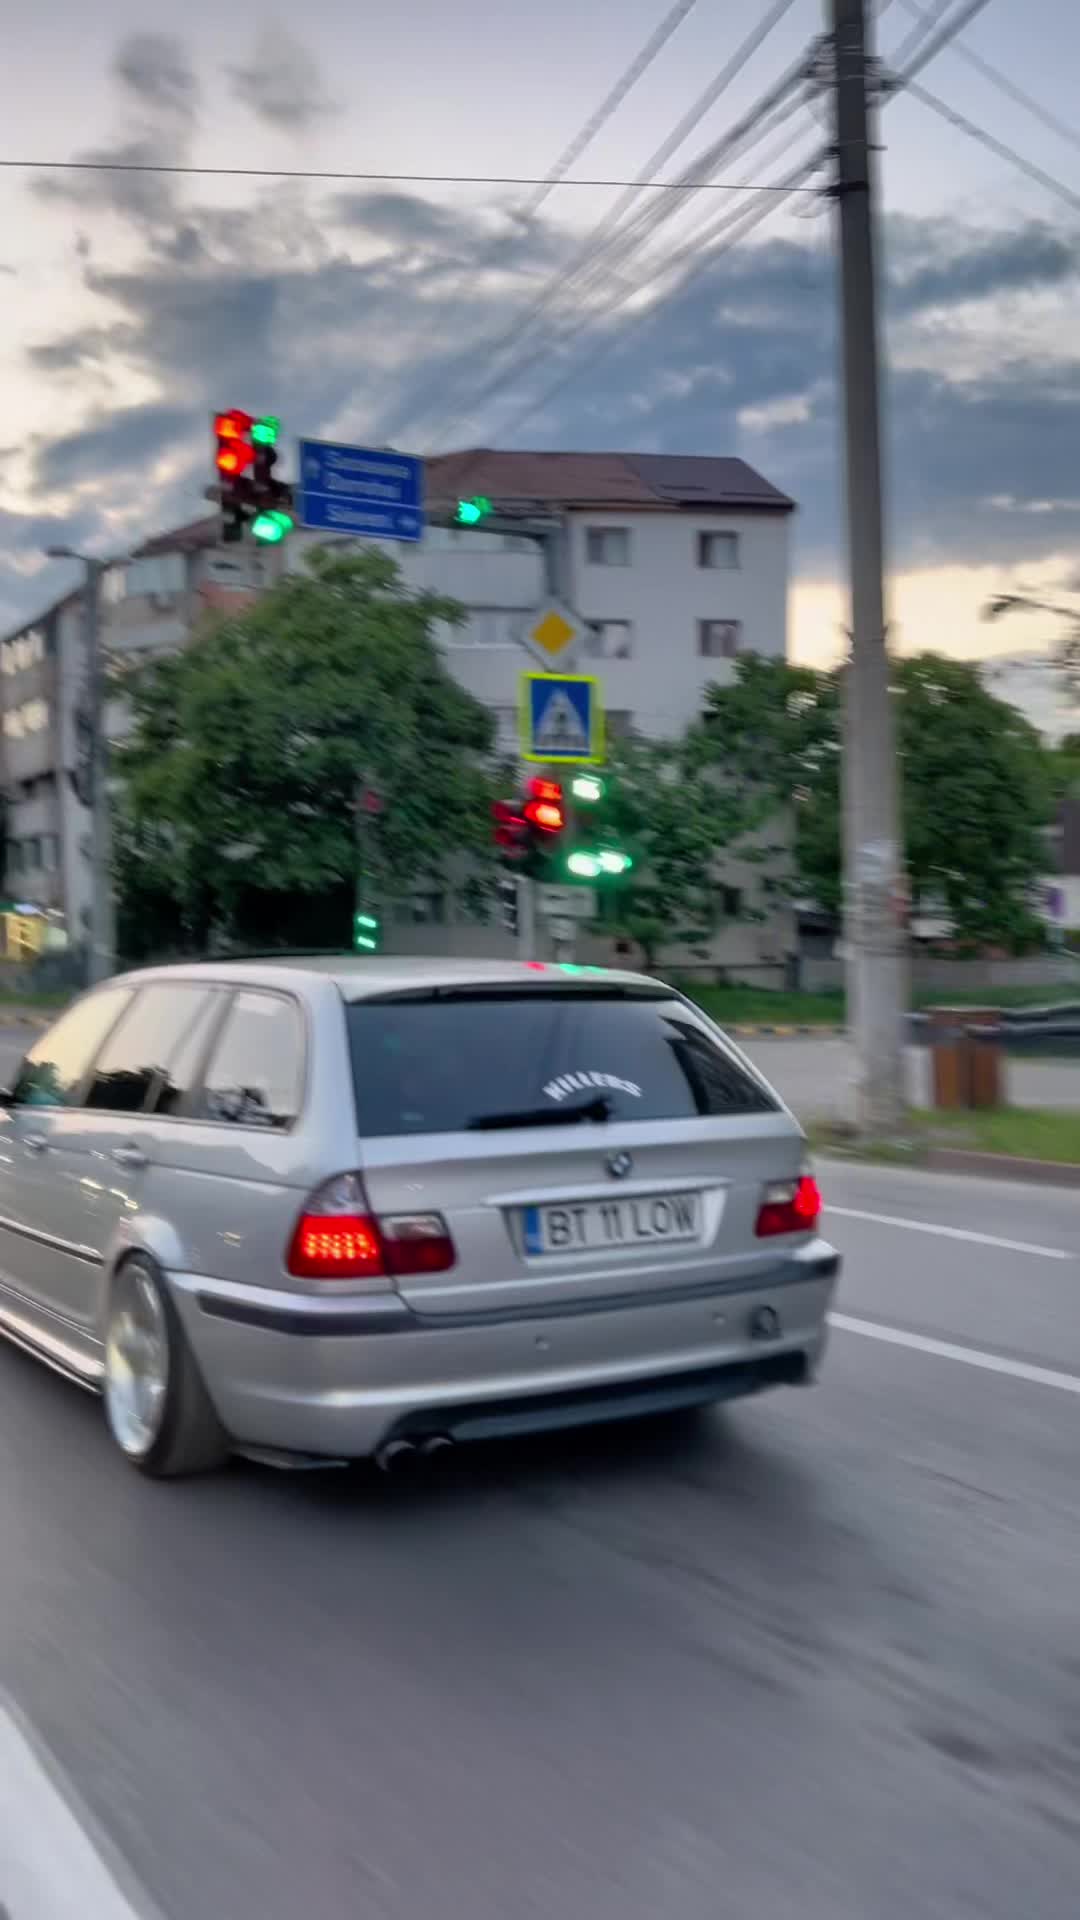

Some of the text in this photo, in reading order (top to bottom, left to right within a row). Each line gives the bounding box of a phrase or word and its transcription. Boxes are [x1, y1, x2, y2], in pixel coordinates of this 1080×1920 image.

[548, 1195, 697, 1246] BT 11 LOW
